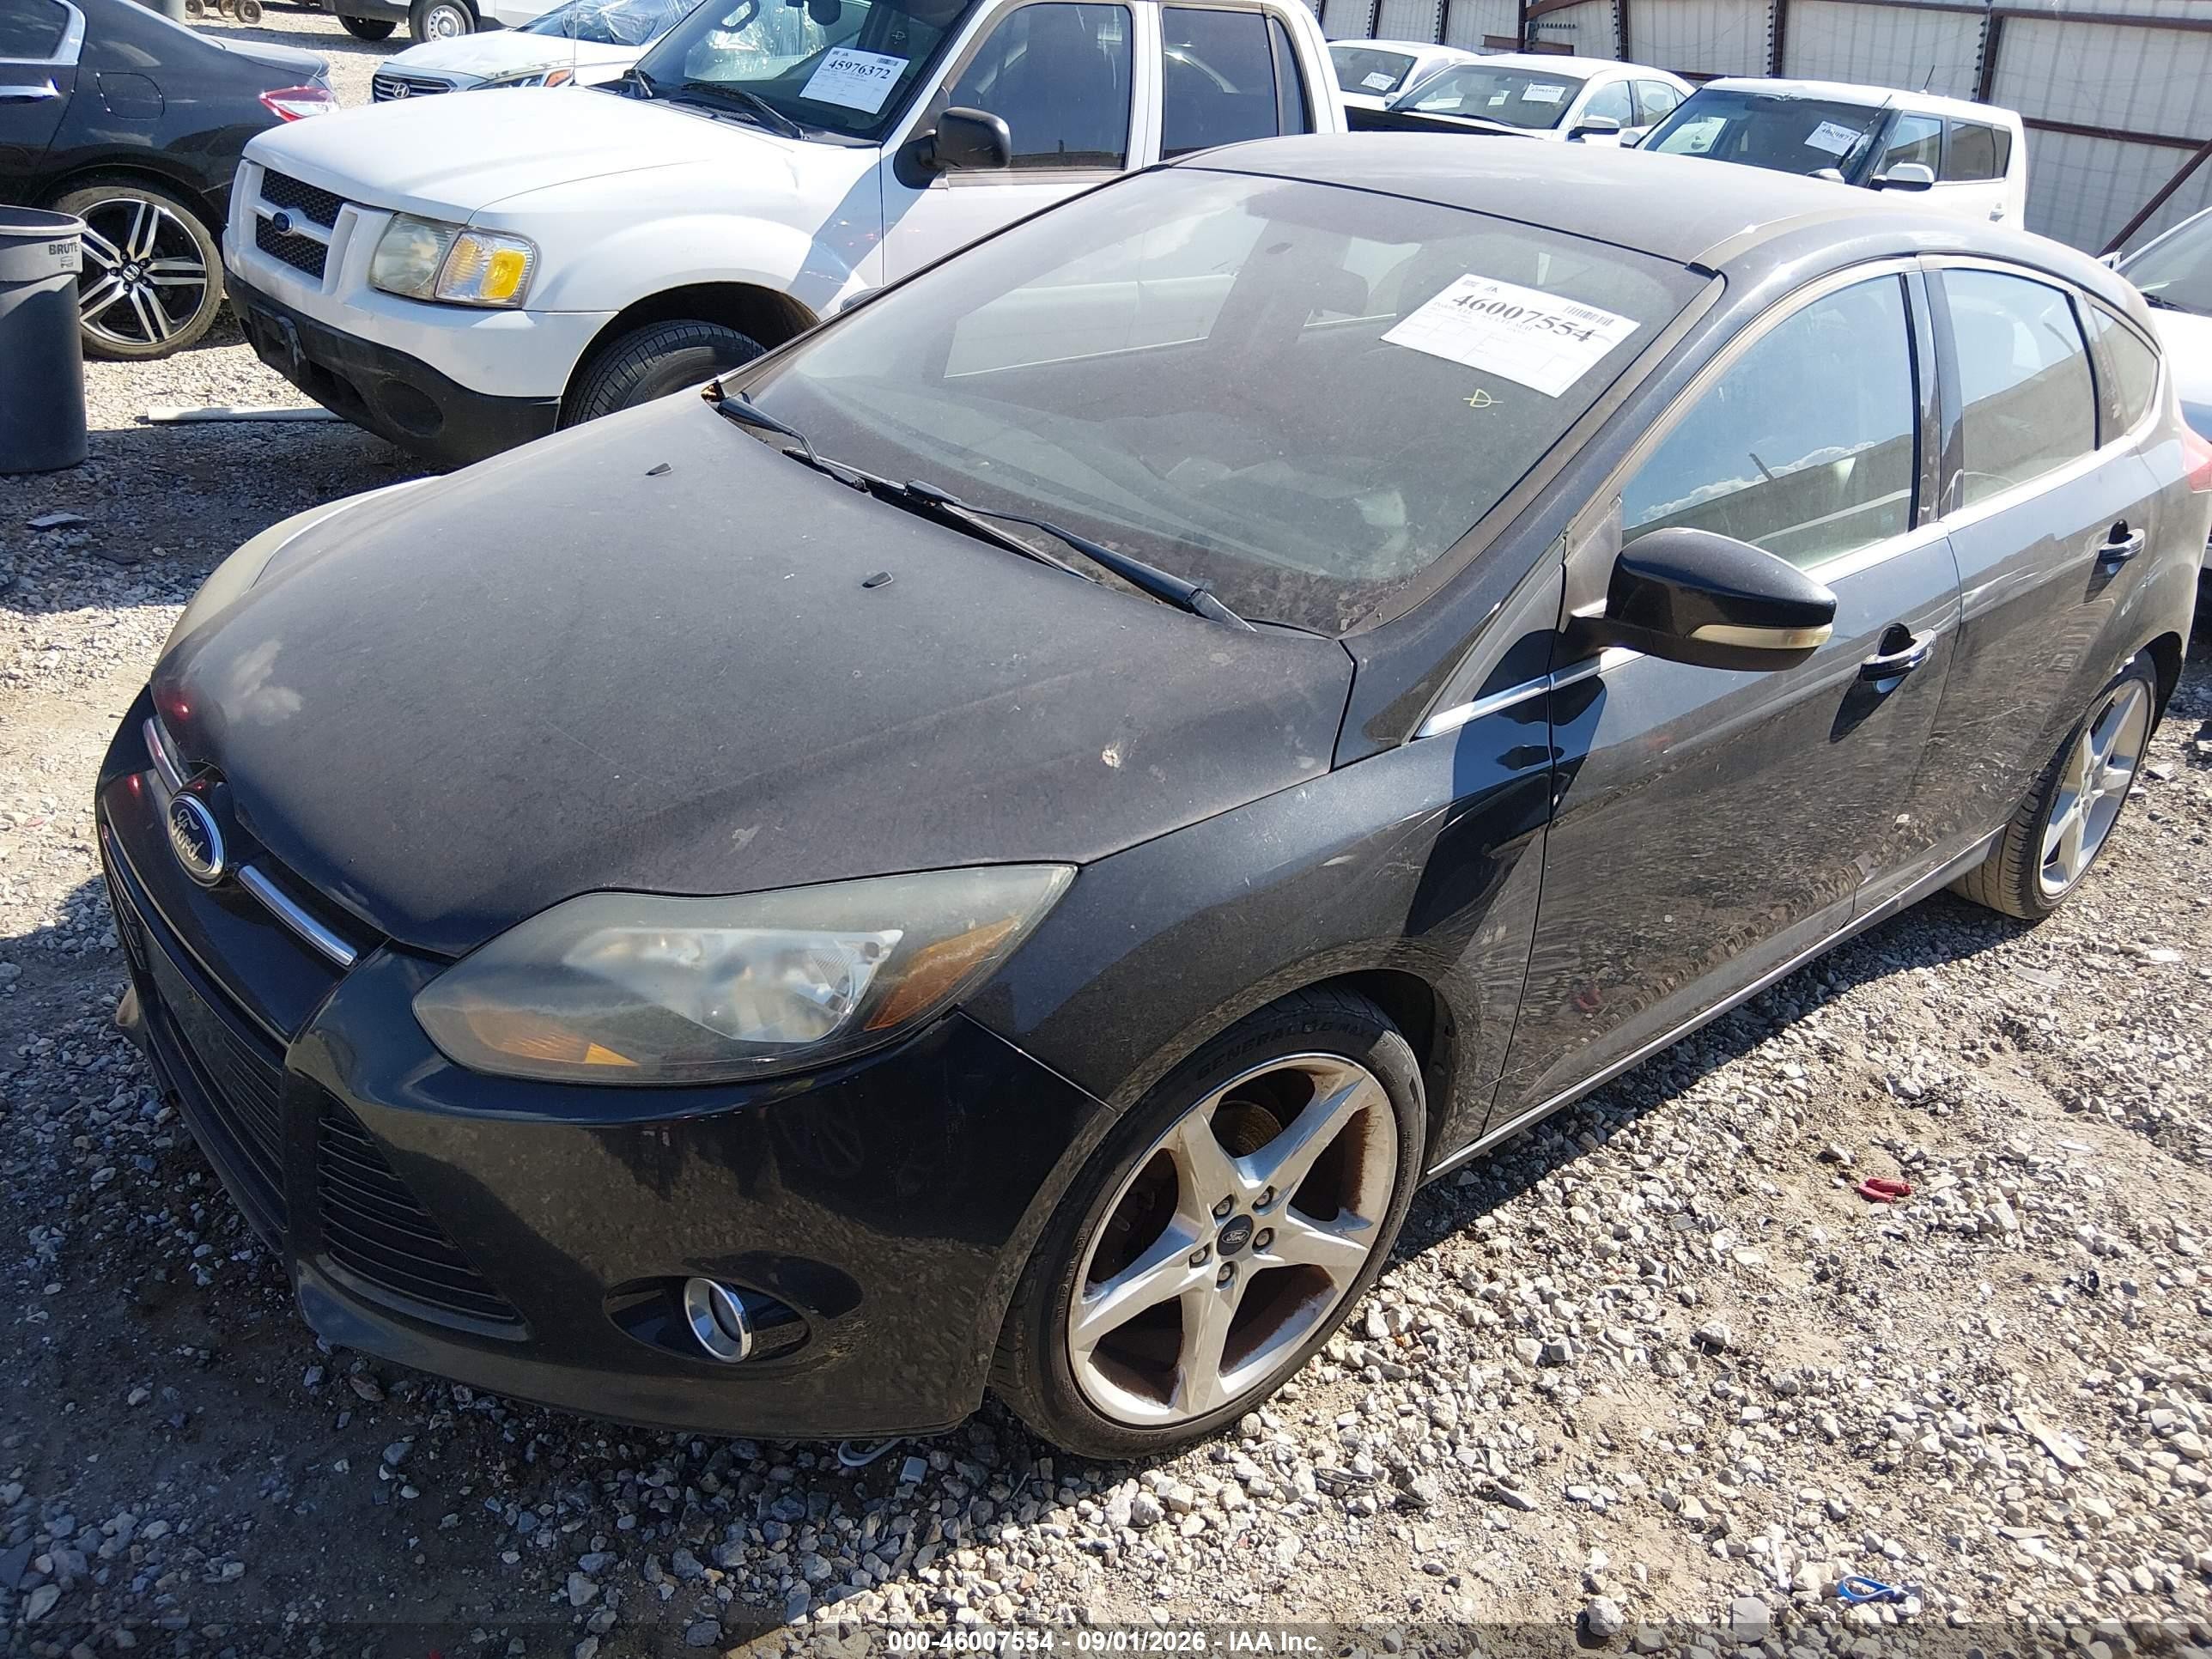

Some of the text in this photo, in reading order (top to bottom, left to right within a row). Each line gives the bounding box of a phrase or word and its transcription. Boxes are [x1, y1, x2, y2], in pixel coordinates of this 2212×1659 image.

[829, 59, 891, 79] 45976372
[48, 241, 78, 255] BRUTE
[1452, 295, 1595, 342] 46007554
[172, 808, 204, 861] Ford
